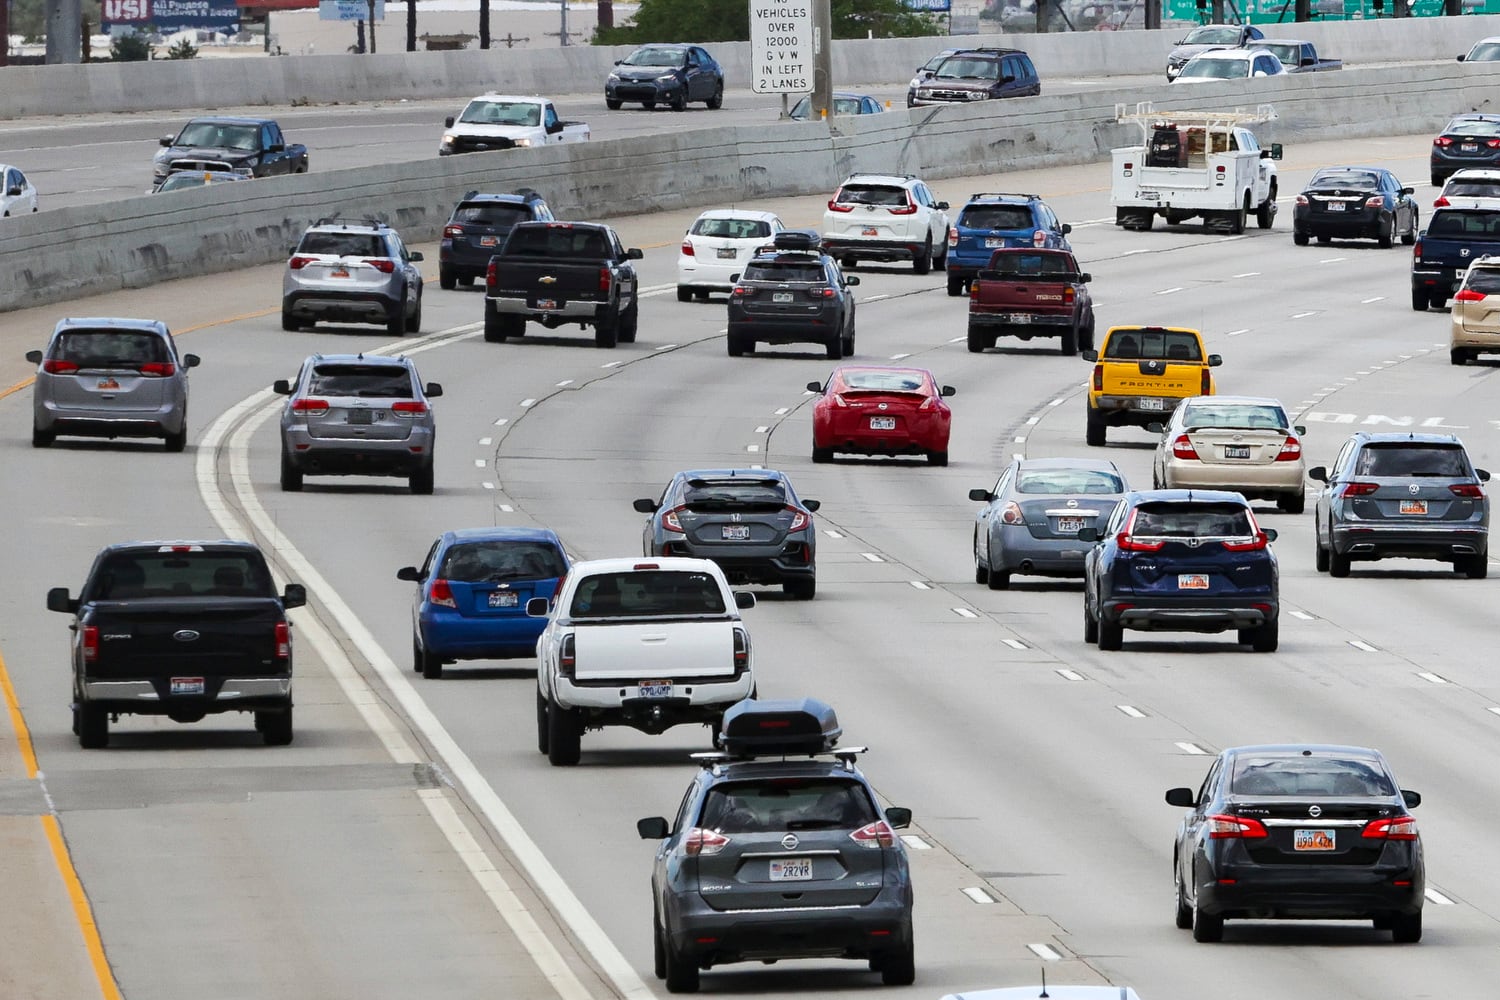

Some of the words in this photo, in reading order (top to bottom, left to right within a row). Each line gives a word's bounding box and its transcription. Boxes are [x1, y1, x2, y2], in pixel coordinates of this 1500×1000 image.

[105, 0, 148, 19] USI
[756, 8, 807, 18] VEHICLES
[768, 22, 795, 32] OVER
[766, 36, 798, 46] 12000
[766, 51, 773, 61] G
[778, 51, 785, 60] V
[790, 51, 798, 60] W
[762, 65, 773, 75] IN
[778, 64, 803, 75] LEFT
[760, 79, 767, 89] 2
[772, 78, 807, 88] LANES
